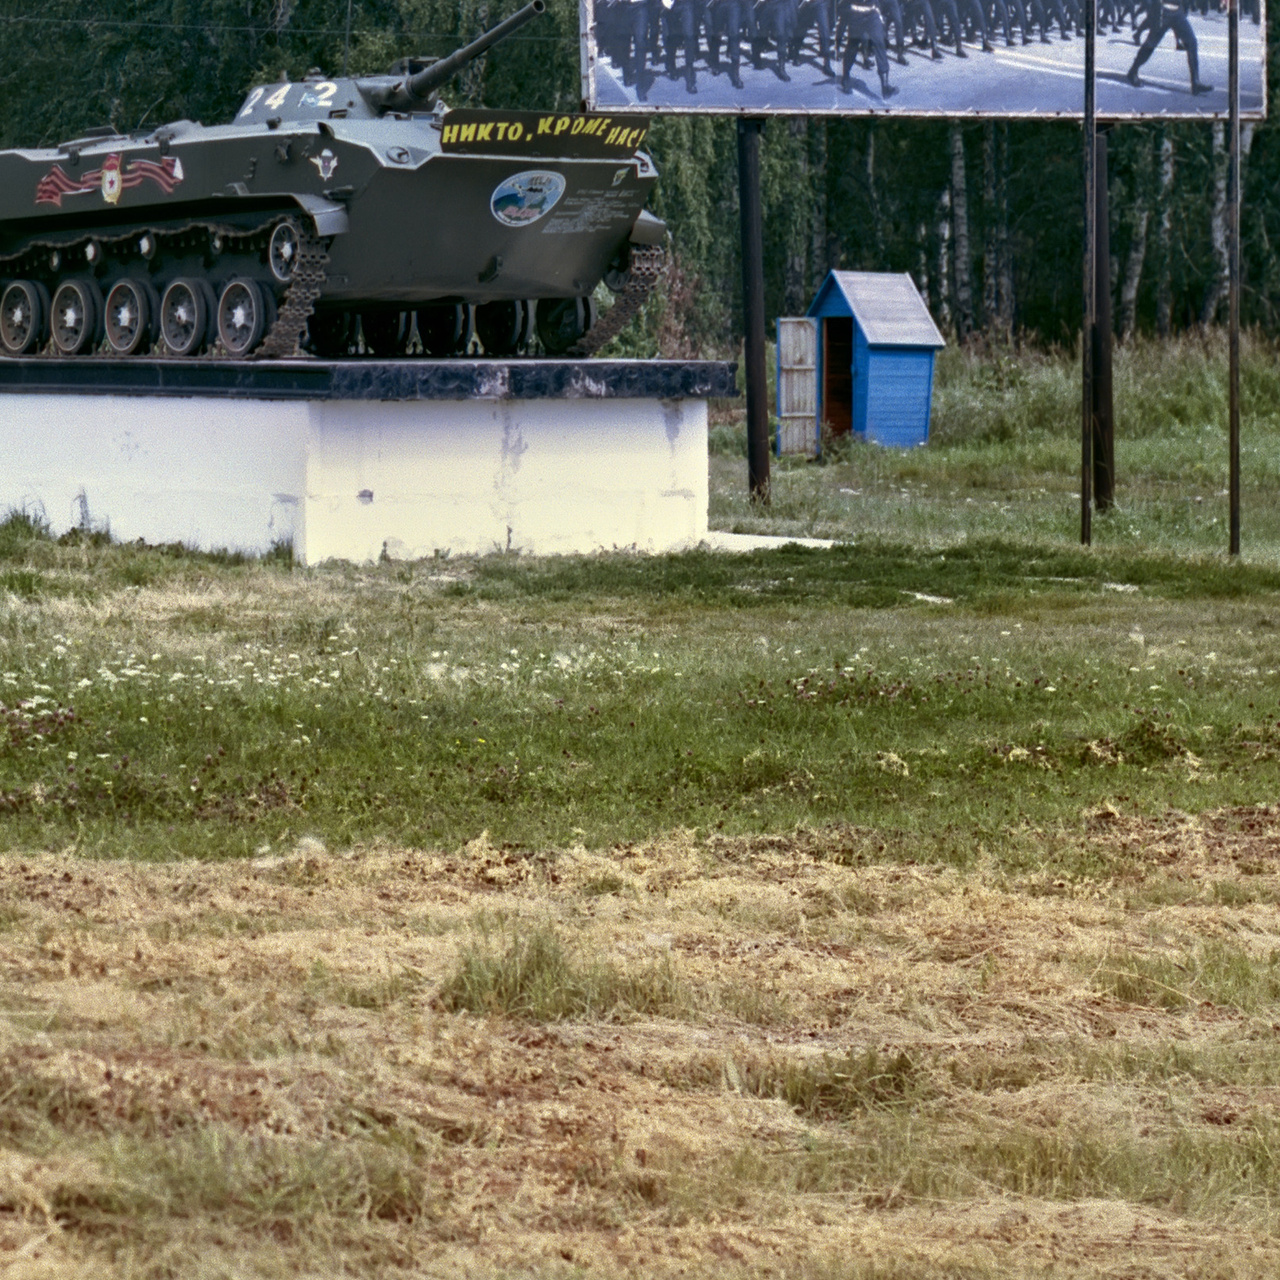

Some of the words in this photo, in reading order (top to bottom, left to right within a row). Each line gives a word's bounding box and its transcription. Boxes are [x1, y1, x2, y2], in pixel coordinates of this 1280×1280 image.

[442, 122, 532, 143] НИКТО,
[537, 116, 612, 137] КРОМЕ
[605, 126, 647, 148] НАС!
